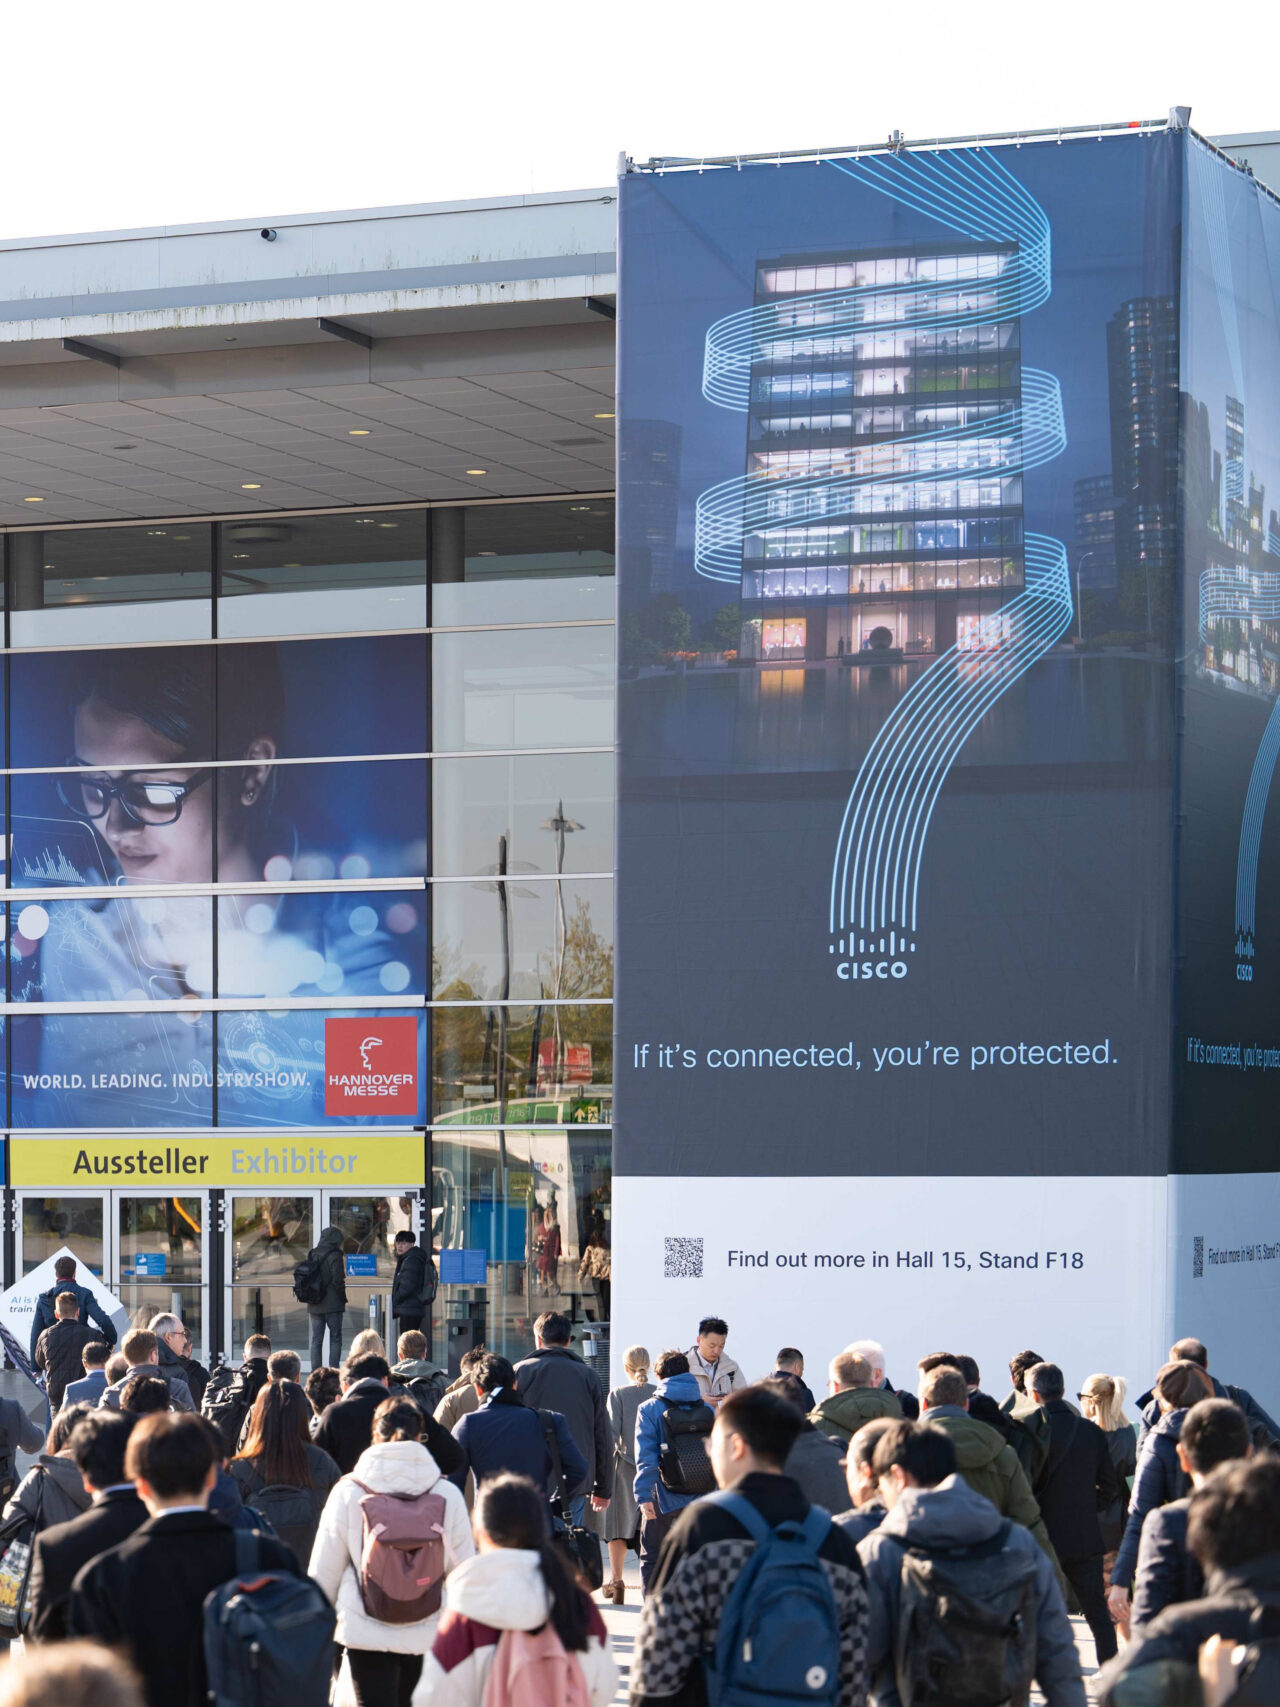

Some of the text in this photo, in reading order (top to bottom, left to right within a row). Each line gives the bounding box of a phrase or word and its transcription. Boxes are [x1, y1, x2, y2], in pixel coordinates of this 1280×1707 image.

[836, 961, 908, 980] CISCO
[633, 1038, 1119, 1072] If it’s connected, you’re protected.
[23, 1072, 311, 1089] WORLD. LEADING. INDUSTRYSHOW.
[328, 1073, 413, 1086] HANNOVER
[343, 1085, 399, 1096] MESSE
[73, 1147, 358, 1175] Aussteller Exhibitor
[727, 1250, 1084, 1271] Find out more in Hall 15, Stand F18
